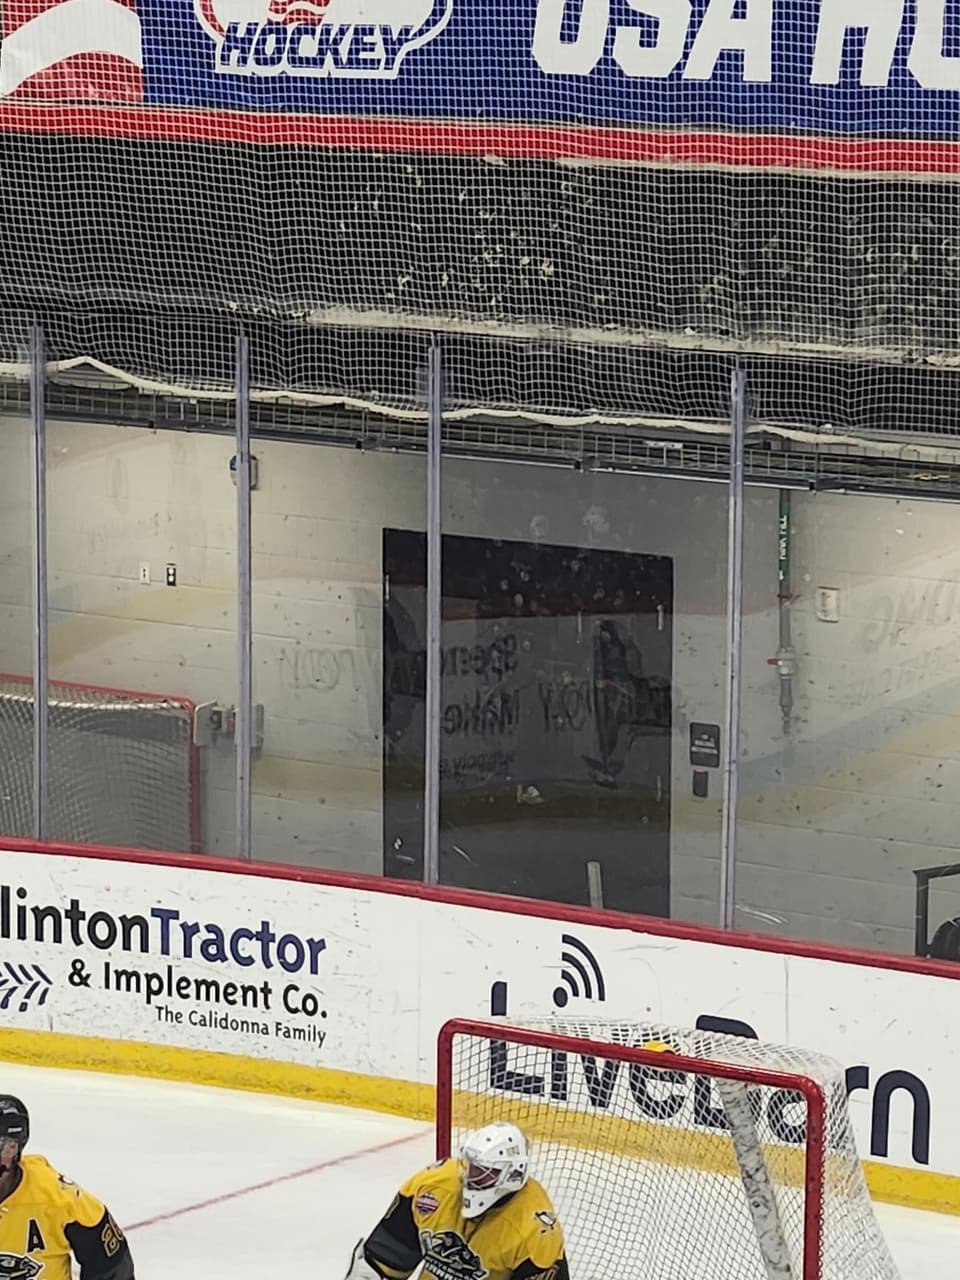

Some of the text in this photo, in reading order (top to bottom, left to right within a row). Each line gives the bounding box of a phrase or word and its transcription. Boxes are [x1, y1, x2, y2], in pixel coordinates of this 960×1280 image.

[220, 22, 416, 71] HOCKEY
[531, 0, 772, 82] USA
[68, 958, 329, 1019] & Implement Co.
[155, 1004, 327, 1048] The Calidonna Family
[26, 1218, 45, 1253] A
